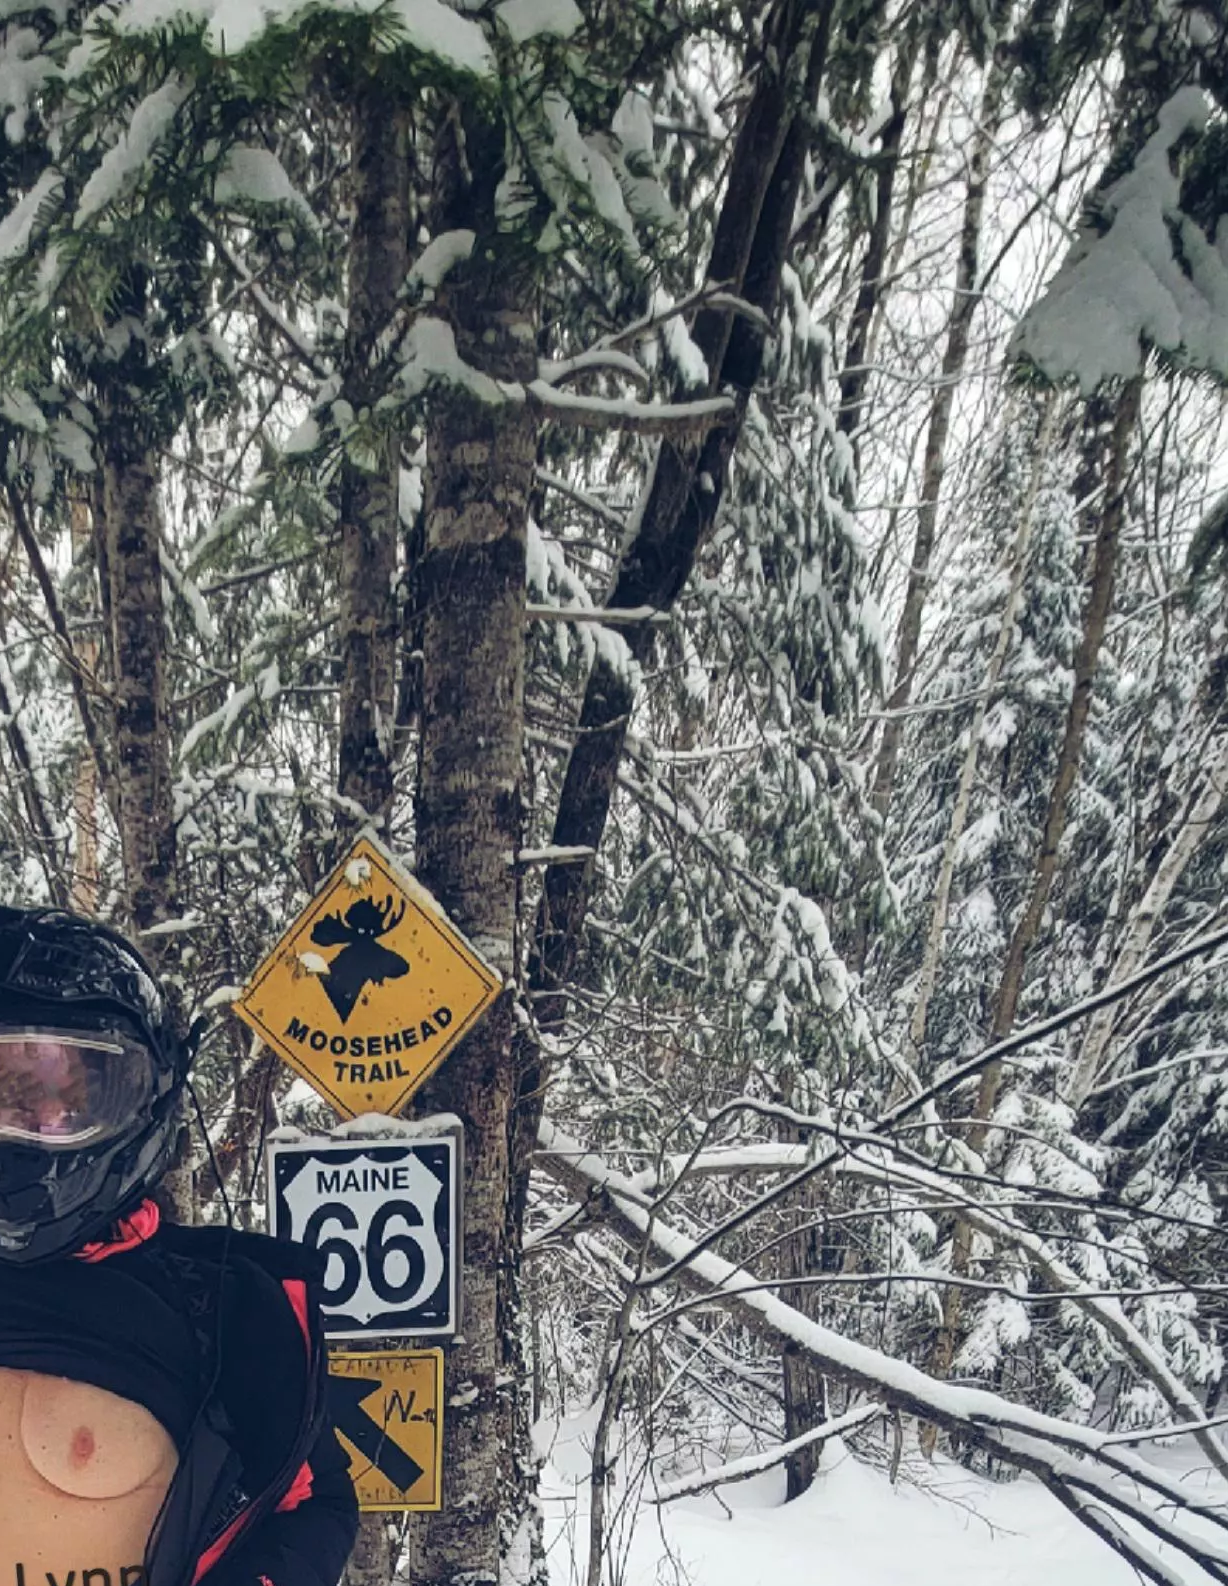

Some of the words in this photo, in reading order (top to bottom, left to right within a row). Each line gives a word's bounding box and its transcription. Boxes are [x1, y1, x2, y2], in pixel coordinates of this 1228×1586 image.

[283, 1006, 454, 1057] MOOSEHEAD
[333, 1059, 410, 1084] TRAIL
[315, 1167, 410, 1195] MAINE
[302, 1199, 426, 1308] 66
